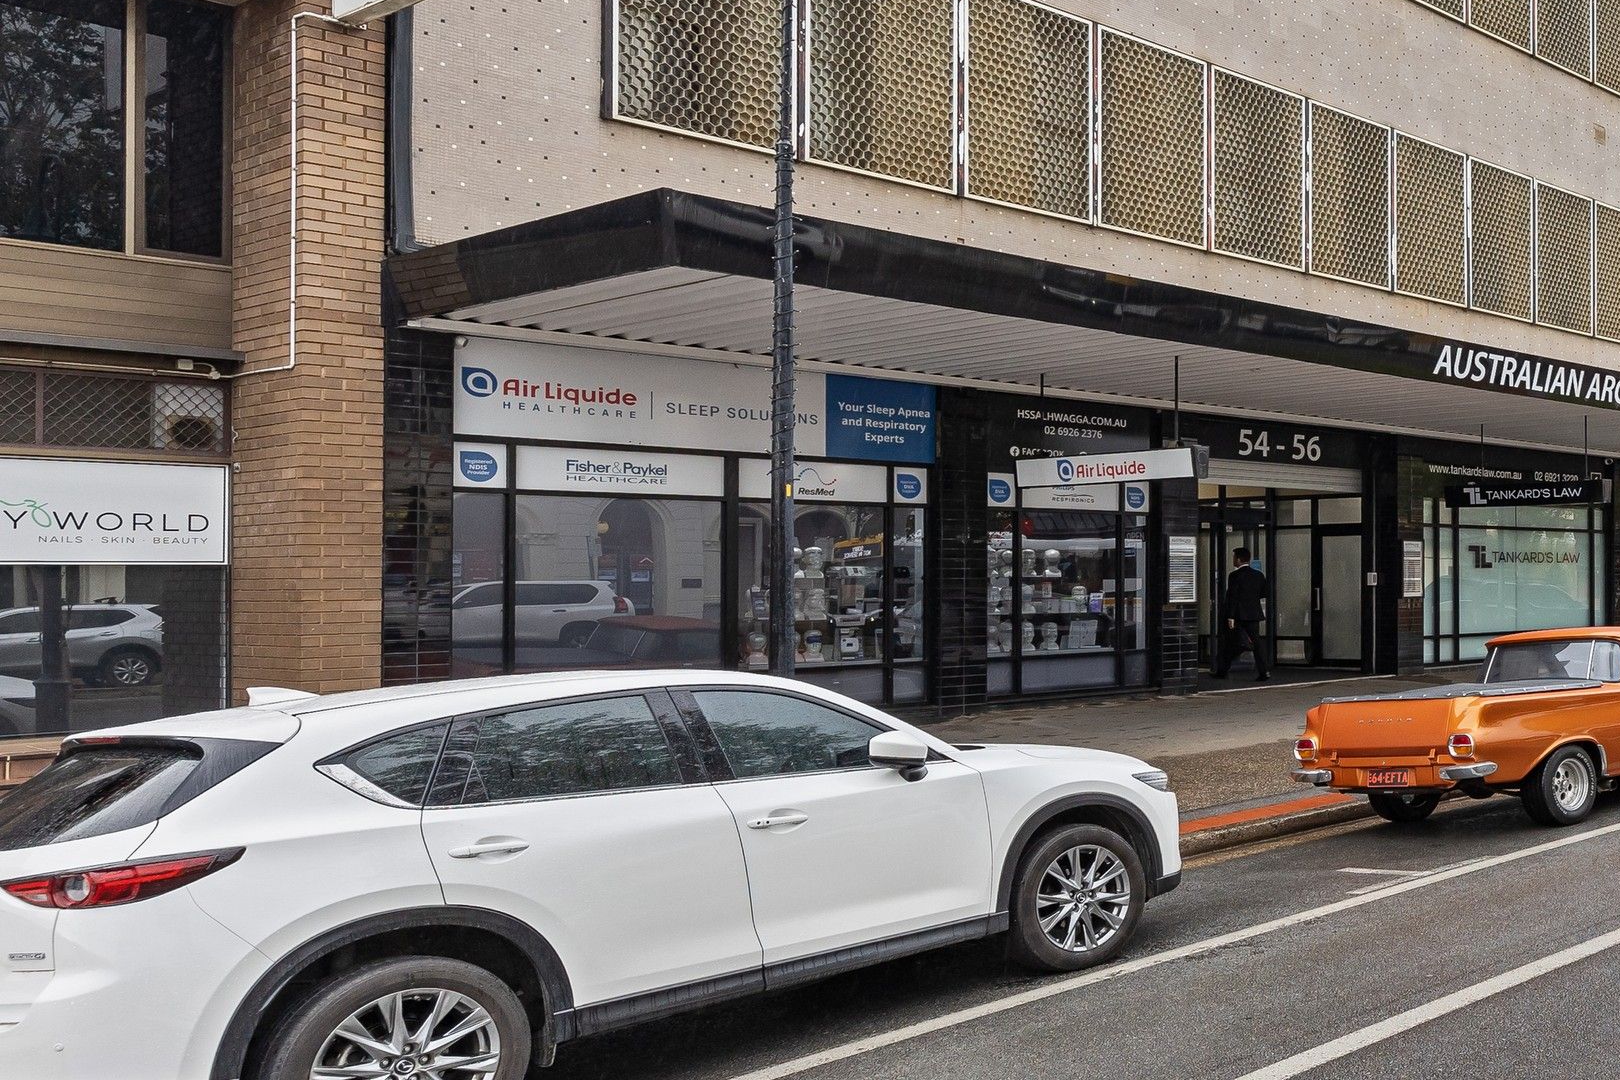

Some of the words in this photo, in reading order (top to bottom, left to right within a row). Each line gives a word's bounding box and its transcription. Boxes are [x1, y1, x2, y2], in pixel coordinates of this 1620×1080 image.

[1433, 346, 1584, 398] AUSTRALIAN
[502, 379, 540, 398] Air
[544, 382, 638, 406] Liquide
[502, 401, 637, 419] HEALTHCARE
[666, 402, 720, 418] SLEEP
[838, 402, 864, 413] Your
[866, 404, 895, 416] Sleep
[897, 407, 931, 419] Apnea
[841, 418, 862, 426] and
[865, 418, 926, 433] Respiratory
[1044, 426, 1056, 435] 02
[1057, 427, 1080, 437] 6926
[1081, 429, 1103, 439] 2376
[864, 432, 905, 444] Experts
[1238, 429, 1270, 457] 54
[1292, 434, 1321, 461] 56
[1076, 463, 1094, 478] Air
[1097, 461, 1146, 479] Liquide
[1534, 471, 1543, 481] 02
[566, 476, 667, 485] HEALTHCARE
[797, 487, 836, 497] ResMed
[1486, 488, 1550, 500] TANKARD'S
[1553, 487, 1583, 498] LAW
[53, 512, 209, 532] WORLD
[38, 536, 83, 544] NAILS
[101, 536, 135, 544] SKIN
[153, 537, 208, 545] BEAUTY
[1492, 551, 1553, 564] TANKARD'S
[1556, 552, 1580, 564] LAW
